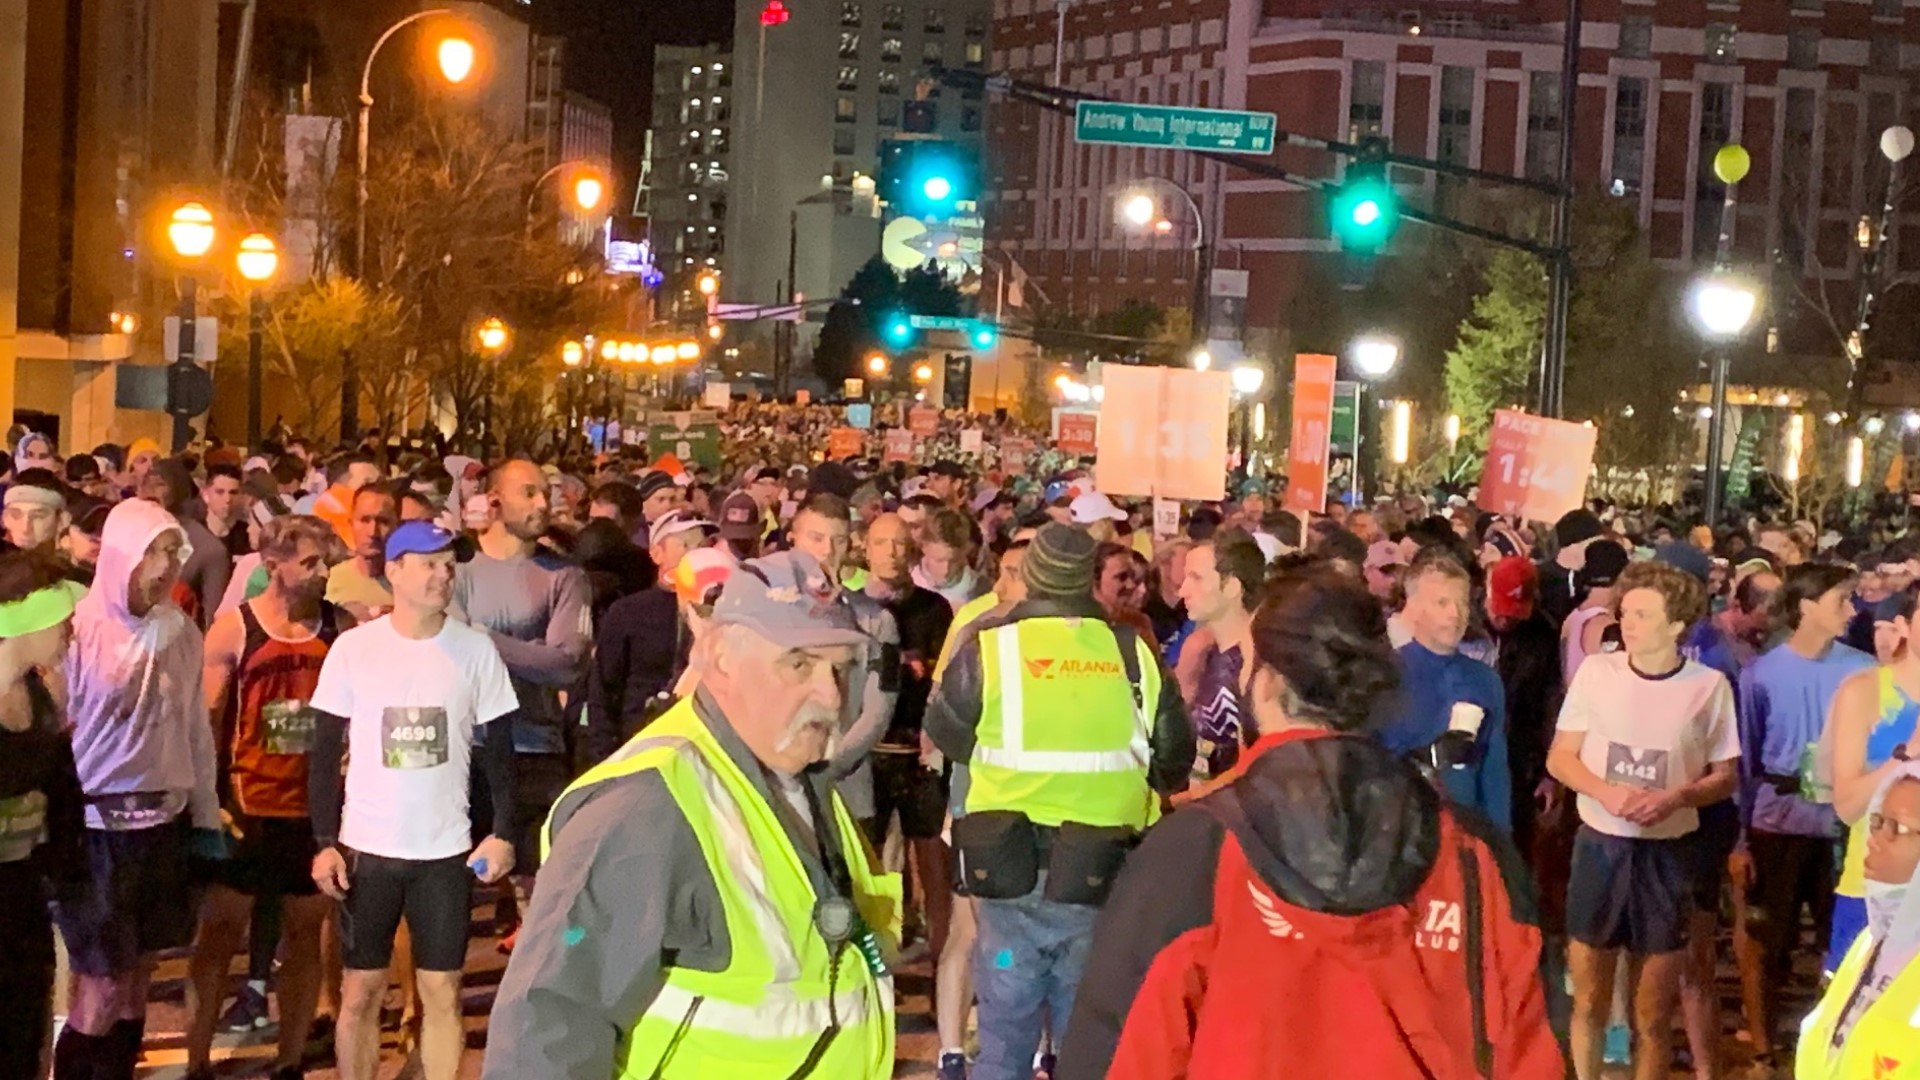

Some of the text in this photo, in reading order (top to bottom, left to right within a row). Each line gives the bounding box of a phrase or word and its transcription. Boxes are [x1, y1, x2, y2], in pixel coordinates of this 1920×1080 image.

[1084, 110, 1126, 131] Andrew
[1133, 112, 1165, 139] Young
[1169, 115, 1244, 138] International
[1059, 659, 1120, 674] ATLANTA
[390, 725, 436, 741] 4698
[1614, 760, 1656, 780] 4142
